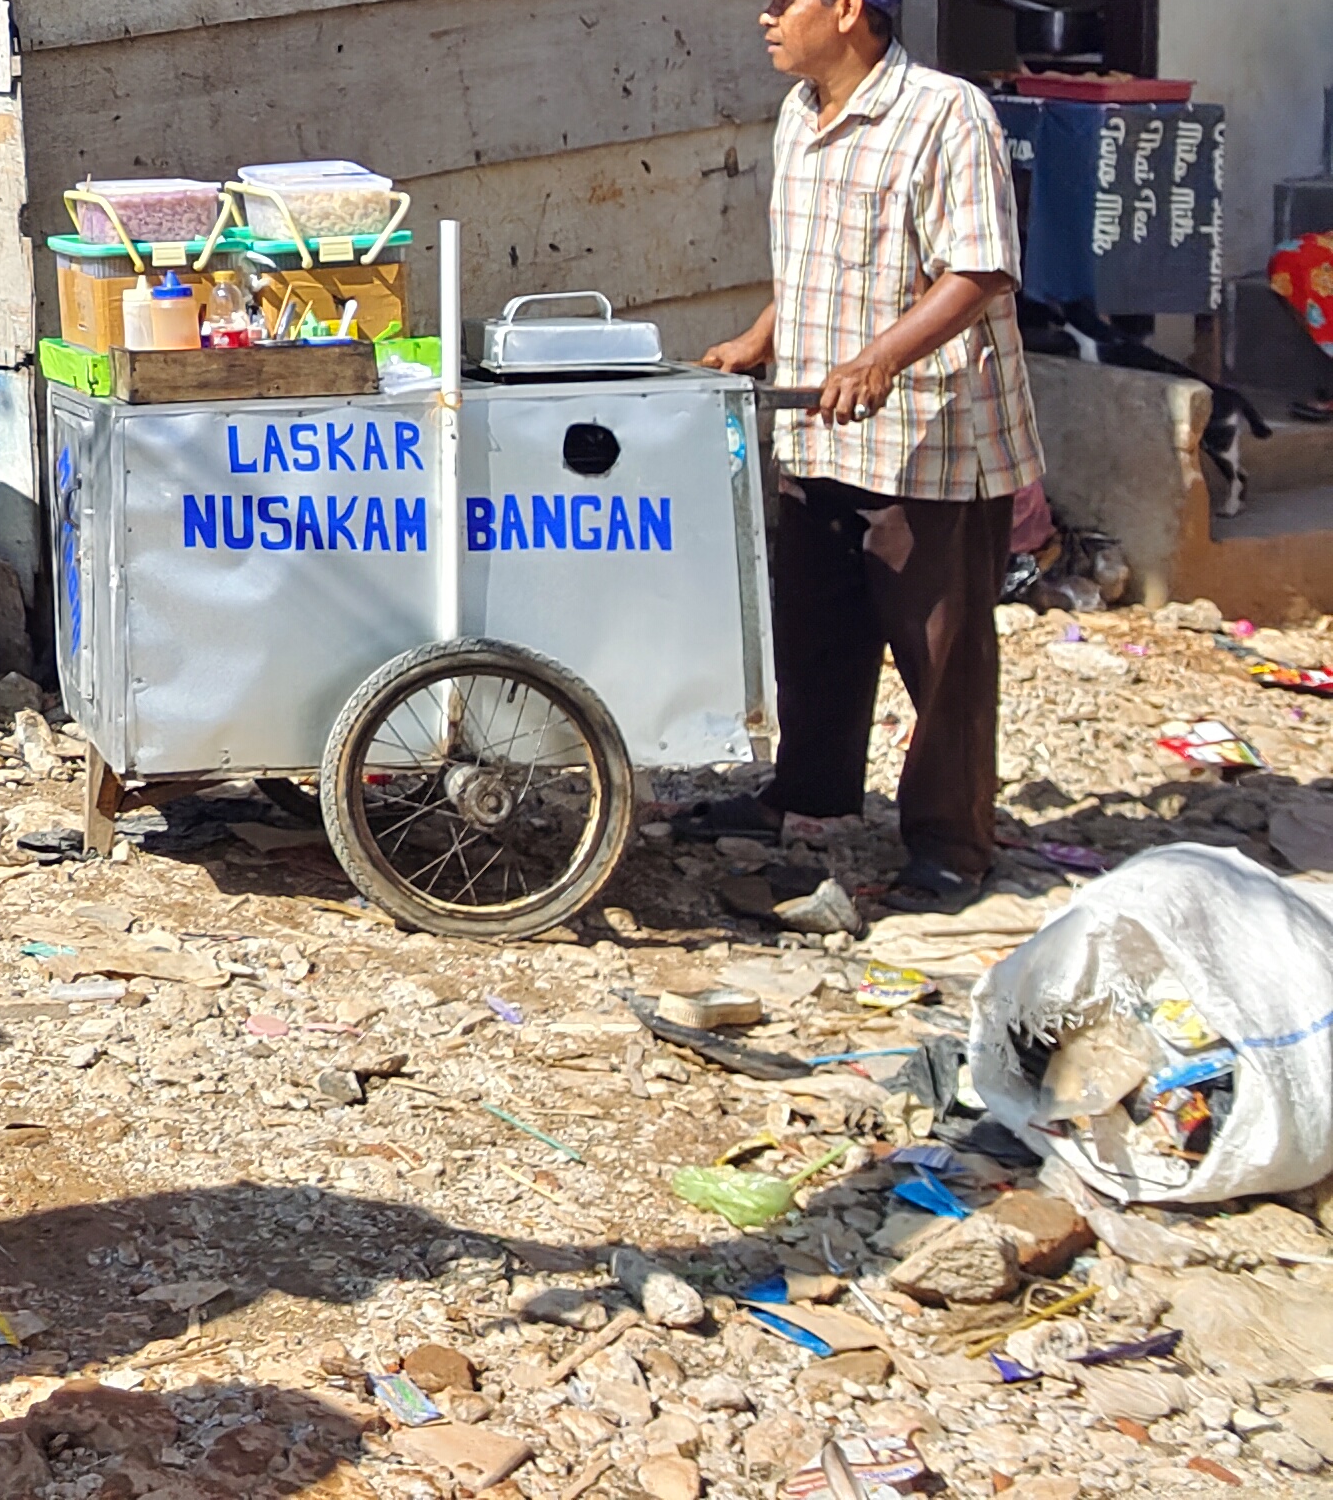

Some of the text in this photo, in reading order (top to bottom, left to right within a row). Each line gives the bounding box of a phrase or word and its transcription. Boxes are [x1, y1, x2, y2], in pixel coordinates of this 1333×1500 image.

[1091, 116, 1126, 256] Taro Milk
[1132, 120, 1164, 244] Thai Tea
[1169, 186, 1196, 248] Milk
[227, 421, 424, 473] LASKAR
[183, 494, 672, 552] NUSAKAM BANGAN
